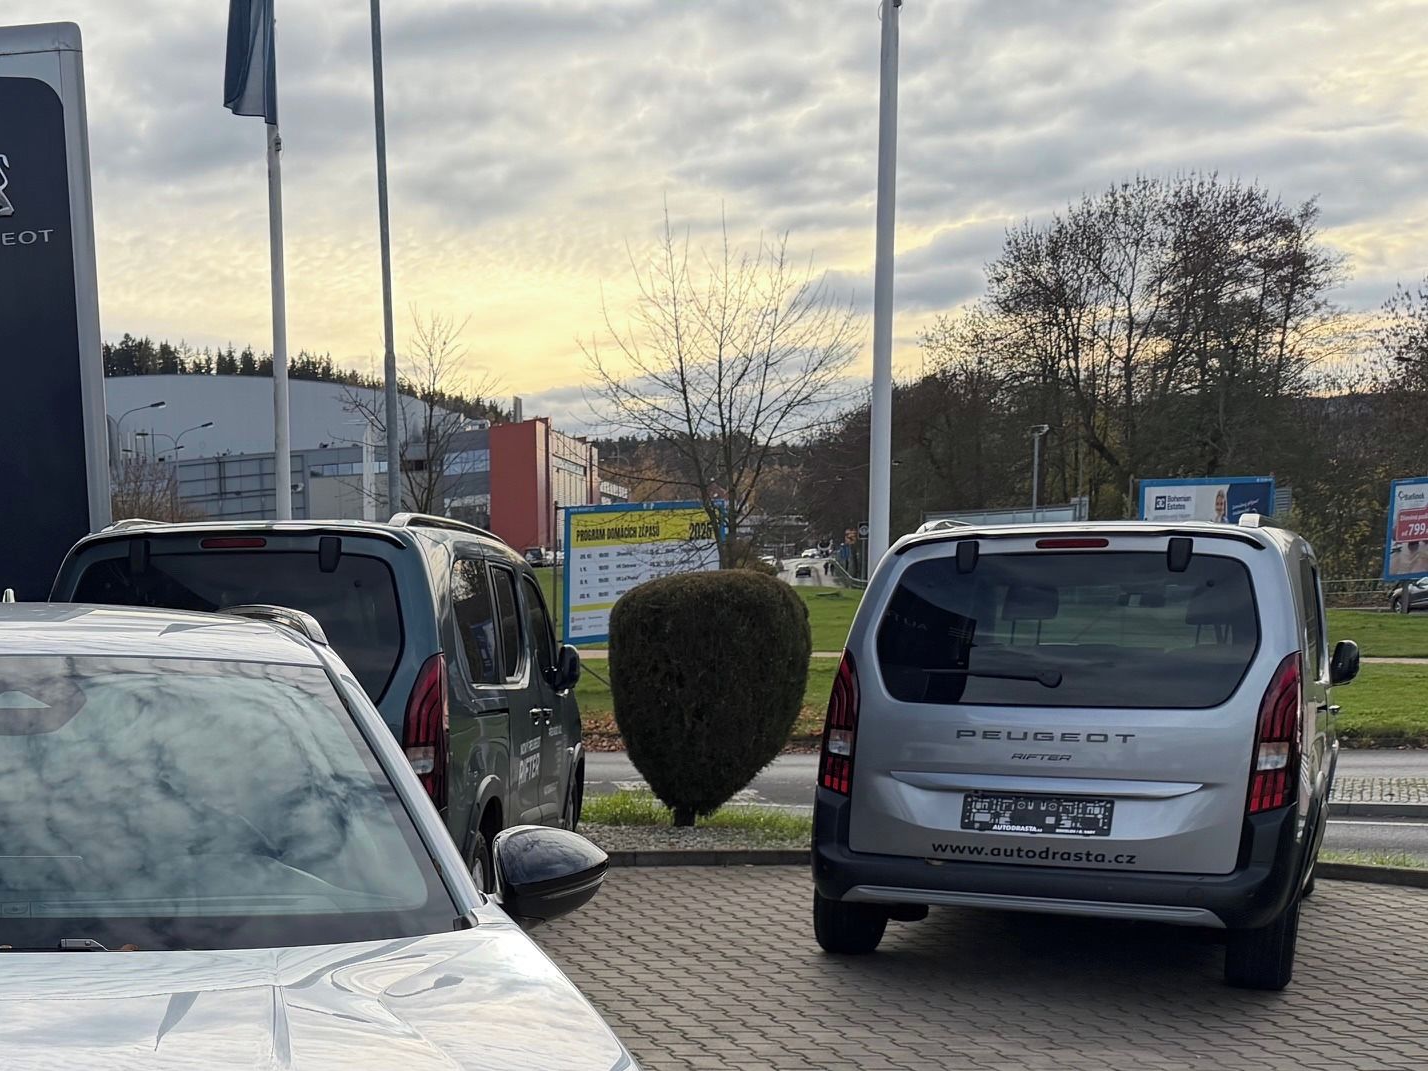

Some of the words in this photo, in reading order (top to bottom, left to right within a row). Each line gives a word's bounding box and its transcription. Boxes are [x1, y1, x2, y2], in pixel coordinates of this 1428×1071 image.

[576, 528, 606, 542] PROGRAM
[606, 523, 638, 540] DOMÁCÍCH
[956, 729, 1136, 744] PEUGEOT
[1011, 752, 1073, 762] RIFTER
[932, 841, 1137, 865] www.autodrasta.cz
